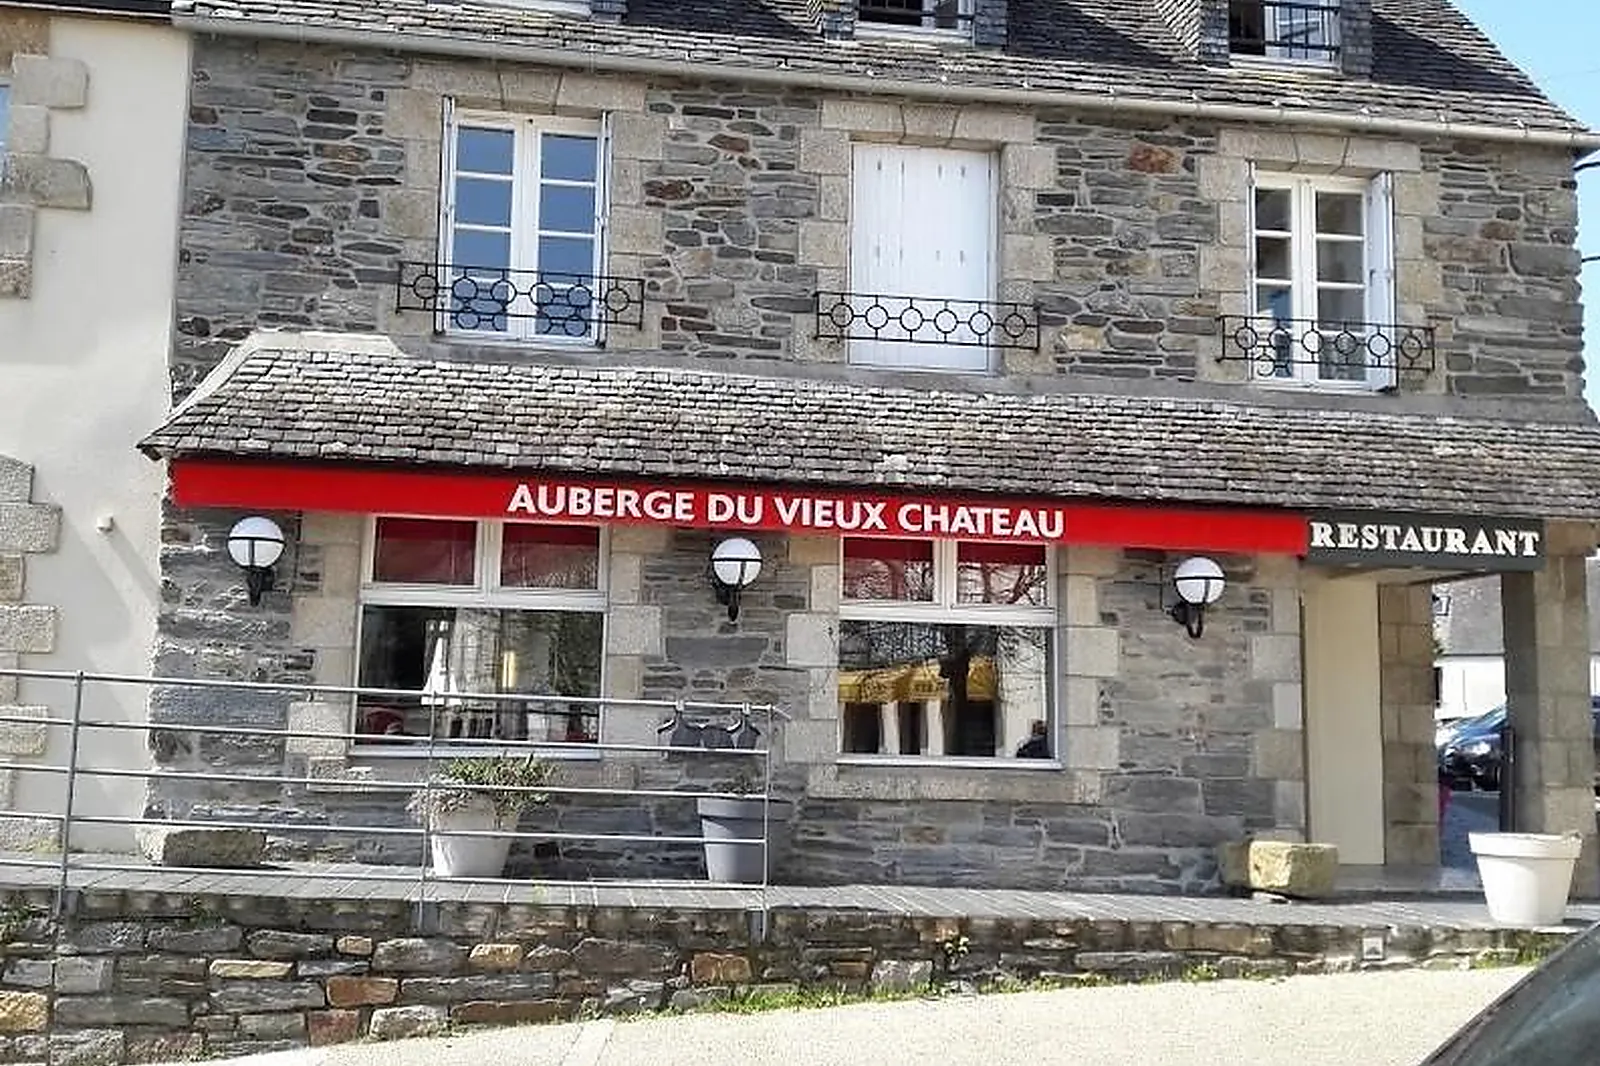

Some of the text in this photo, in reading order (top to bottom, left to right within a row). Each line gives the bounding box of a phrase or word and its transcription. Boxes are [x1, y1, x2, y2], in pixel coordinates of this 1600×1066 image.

[507, 484, 1064, 538] AUBERGE DU VIEUX CHATEAU
[1310, 522, 1540, 556] RESTAURANT
